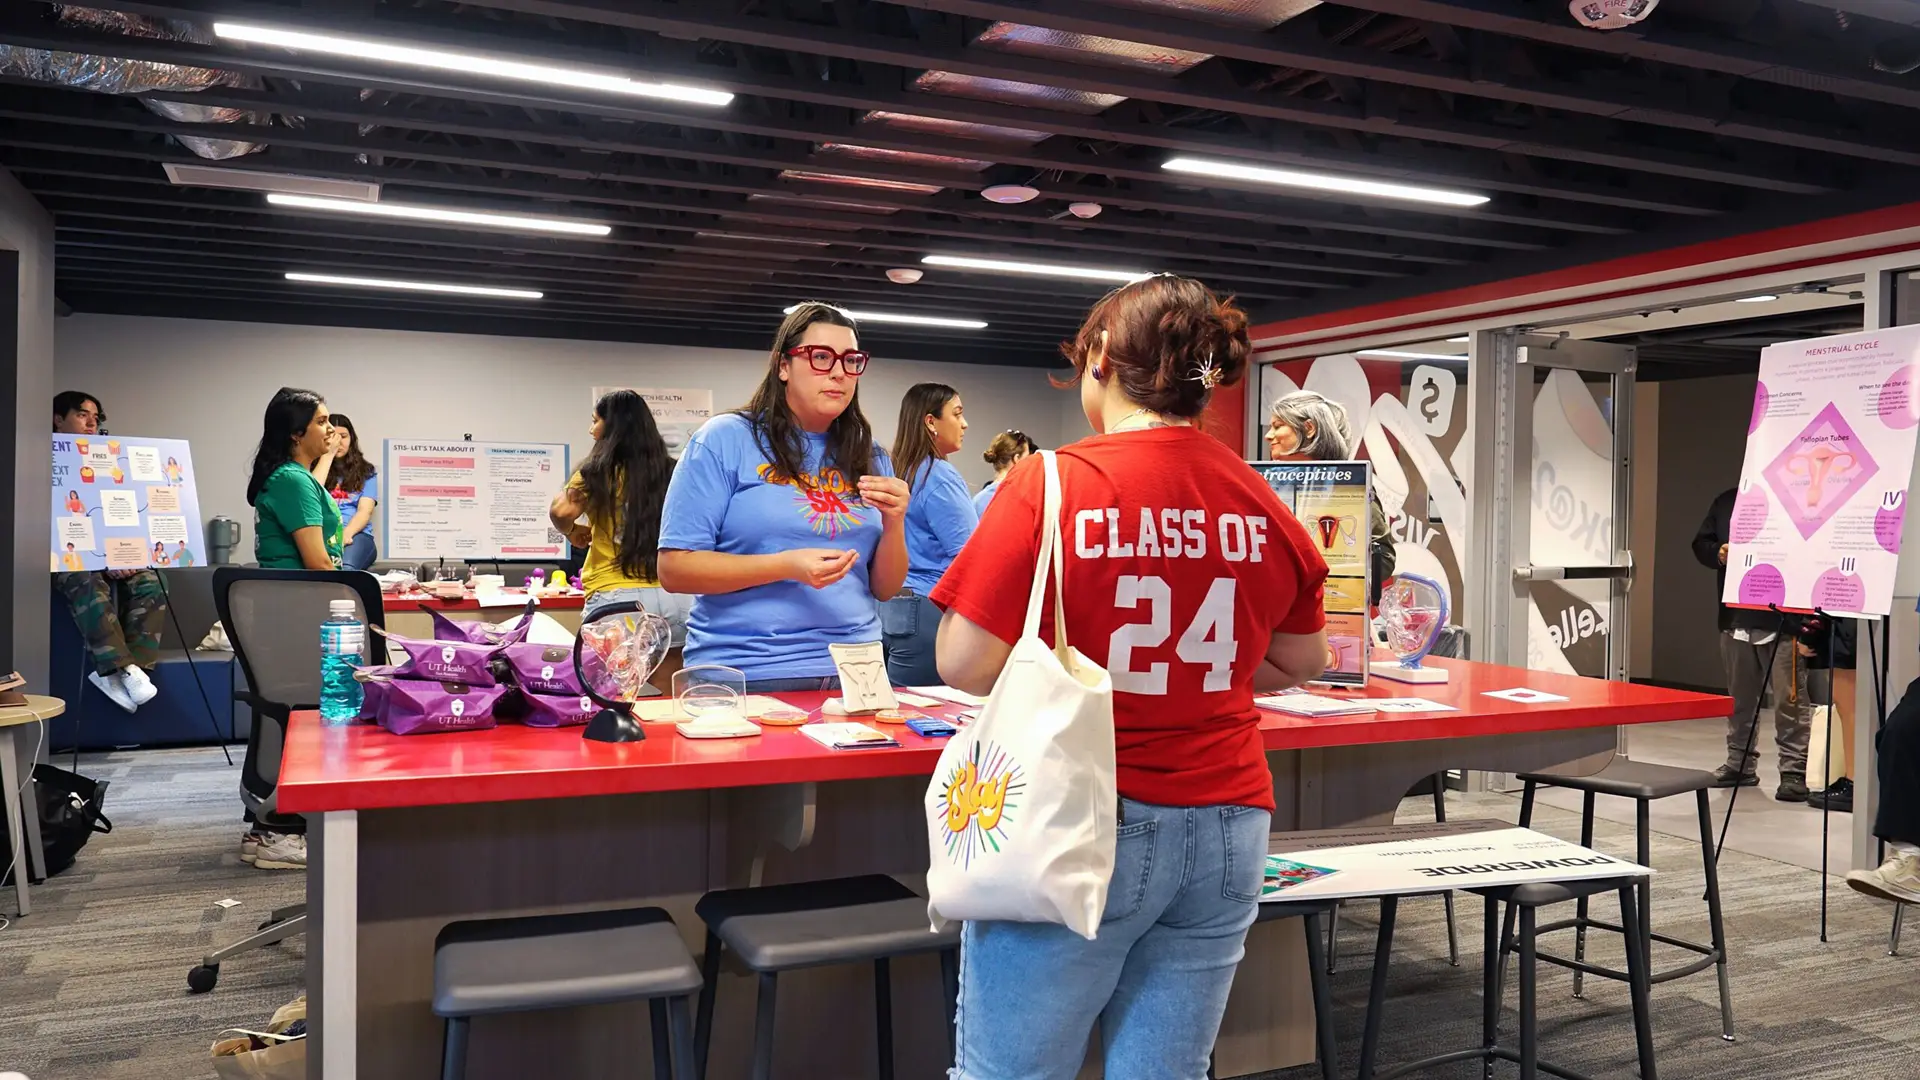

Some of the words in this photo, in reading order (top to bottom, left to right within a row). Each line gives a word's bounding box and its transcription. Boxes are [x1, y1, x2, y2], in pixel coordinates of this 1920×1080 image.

[1806, 344, 1852, 356] MENSTRUAL
[1854, 341, 1880, 351] CYCLE
[52, 441, 71, 452] ENT
[52, 465, 69, 475] EXT
[1262, 467, 1352, 484] traceptives
[52, 477, 63, 486] EX
[806, 488, 850, 513] SA
[1883, 492, 1900, 505] IV
[1075, 507, 1206, 559] CLASS
[1218, 513, 1268, 562] OF
[1744, 554, 1752, 567] II
[1841, 557, 1855, 571] III
[1107, 575, 1238, 695] 24
[429, 663, 442, 671] UT
[443, 664, 467, 673] Health
[544, 681, 565, 690] Health
[454, 716, 477, 725] Health
[946, 760, 1013, 832] Slay
[1416, 856, 1615, 877] POWERADE
